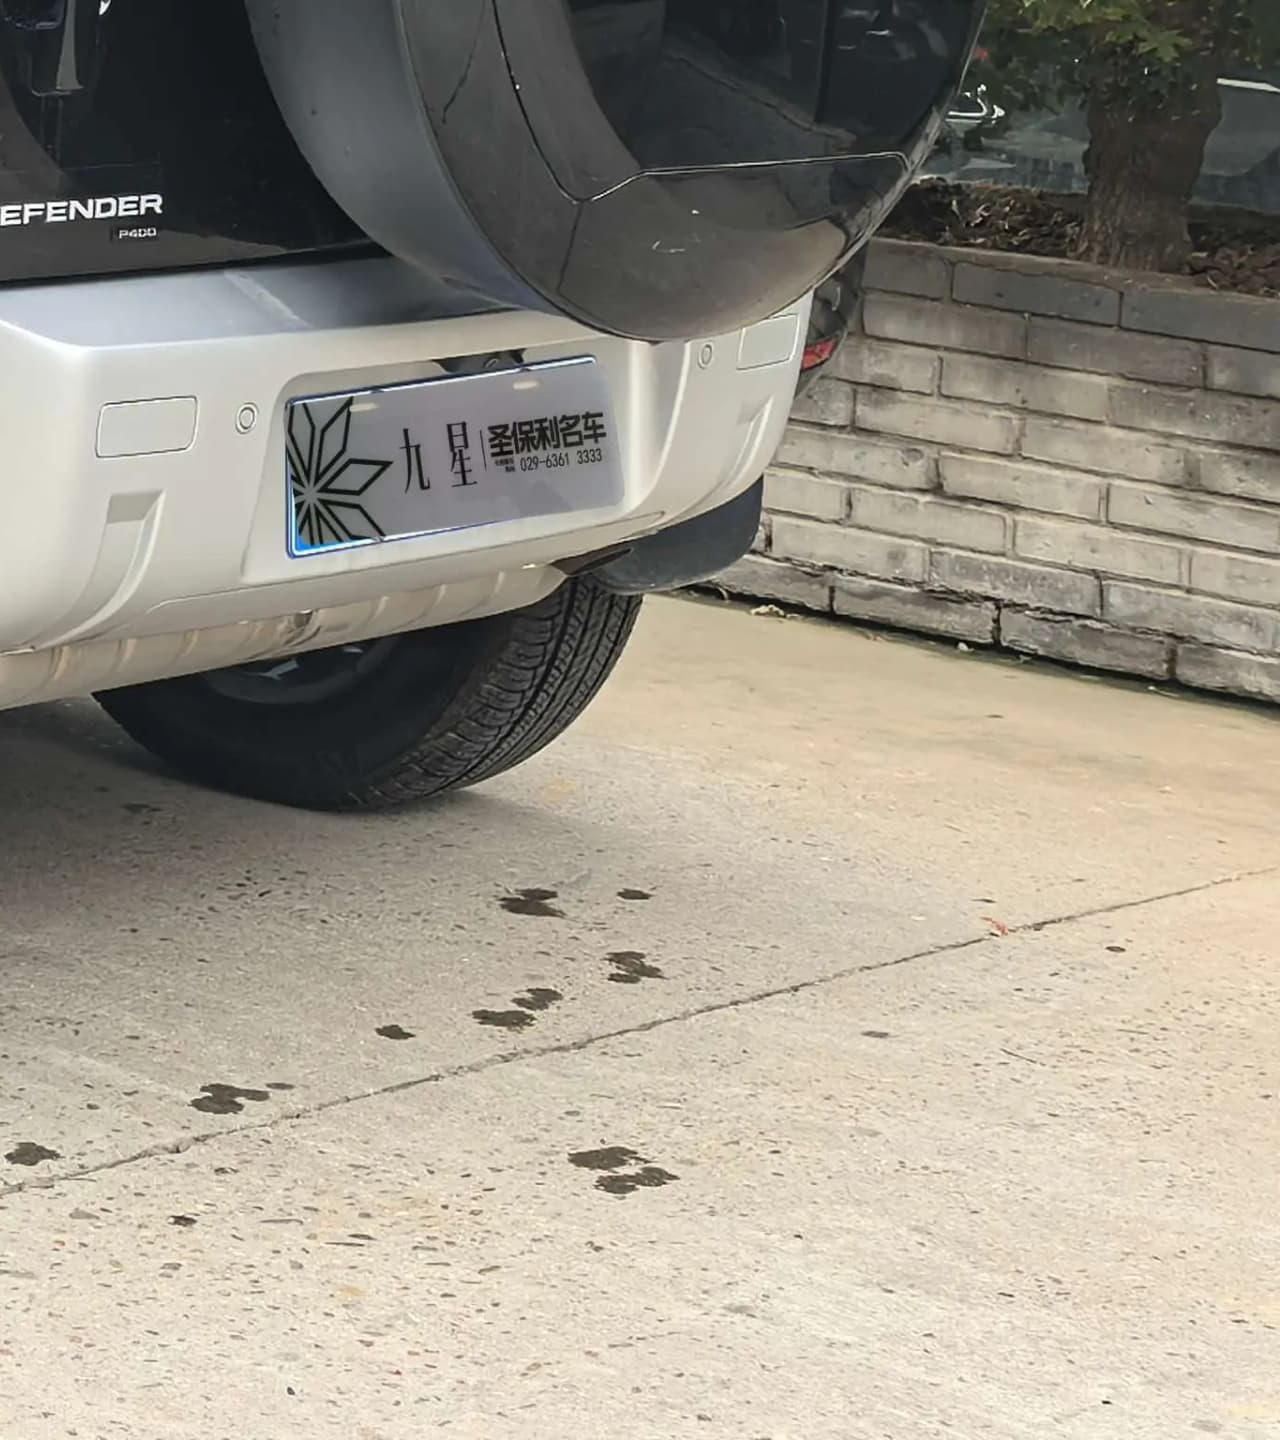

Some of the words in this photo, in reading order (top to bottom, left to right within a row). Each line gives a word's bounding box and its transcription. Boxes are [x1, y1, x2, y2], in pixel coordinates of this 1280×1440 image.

[399, 420, 478, 494] 九星
[487, 411, 607, 458] 圣保利名车
[519, 451, 570, 472] 029-6361
[576, 447, 603, 465] 3333
